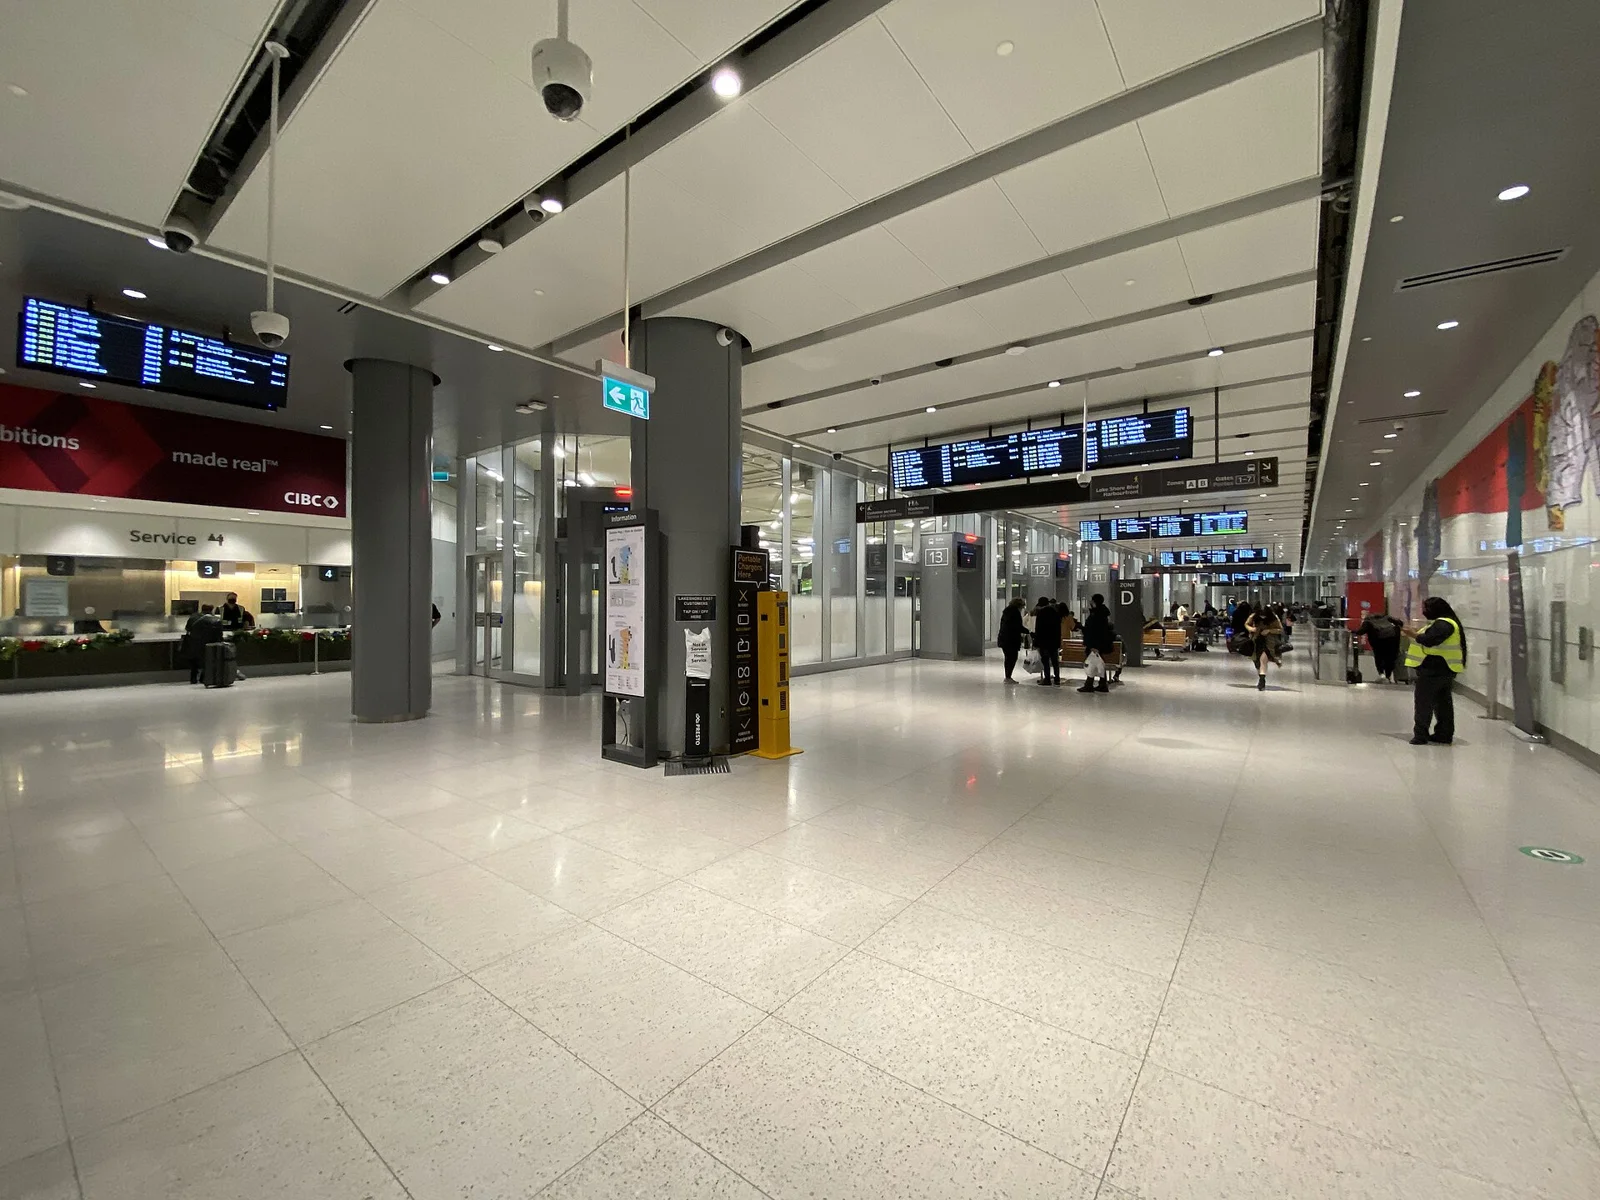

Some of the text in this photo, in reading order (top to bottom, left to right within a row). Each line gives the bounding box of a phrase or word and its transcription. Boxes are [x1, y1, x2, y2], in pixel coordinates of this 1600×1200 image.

[0, 424, 80, 450] bitions
[172, 449, 228, 469] made
[284, 491, 322, 508] CIBC
[611, 514, 637, 523] Information
[129, 530, 197, 545] Service
[738, 554, 761, 563] Portable
[930, 551, 943, 564] 13
[204, 565, 213, 575] 3
[738, 561, 763, 573] Chargers
[1034, 565, 1046, 575] 12
[325, 569, 333, 579] 4
[737, 570, 752, 578] Here
[1121, 590, 1134, 605] D
